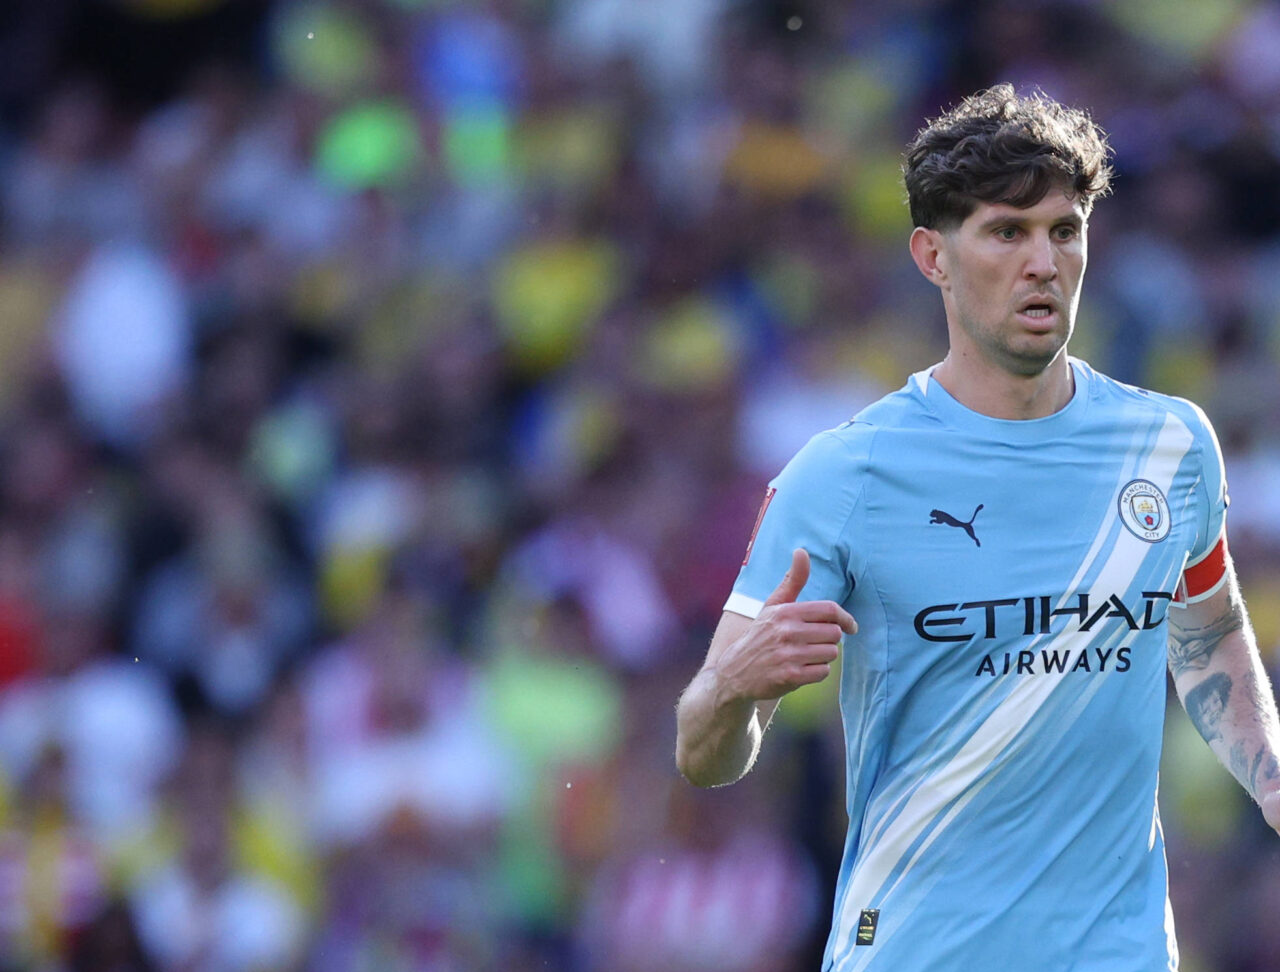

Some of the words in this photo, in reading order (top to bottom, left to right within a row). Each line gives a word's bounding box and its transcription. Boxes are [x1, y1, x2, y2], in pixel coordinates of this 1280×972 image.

[1122, 483, 1164, 504] MANCHESTER
[1144, 531, 1160, 539] CITY
[913, 591, 1173, 643] ETIHAD
[975, 646, 1132, 678] AIRWAYS
